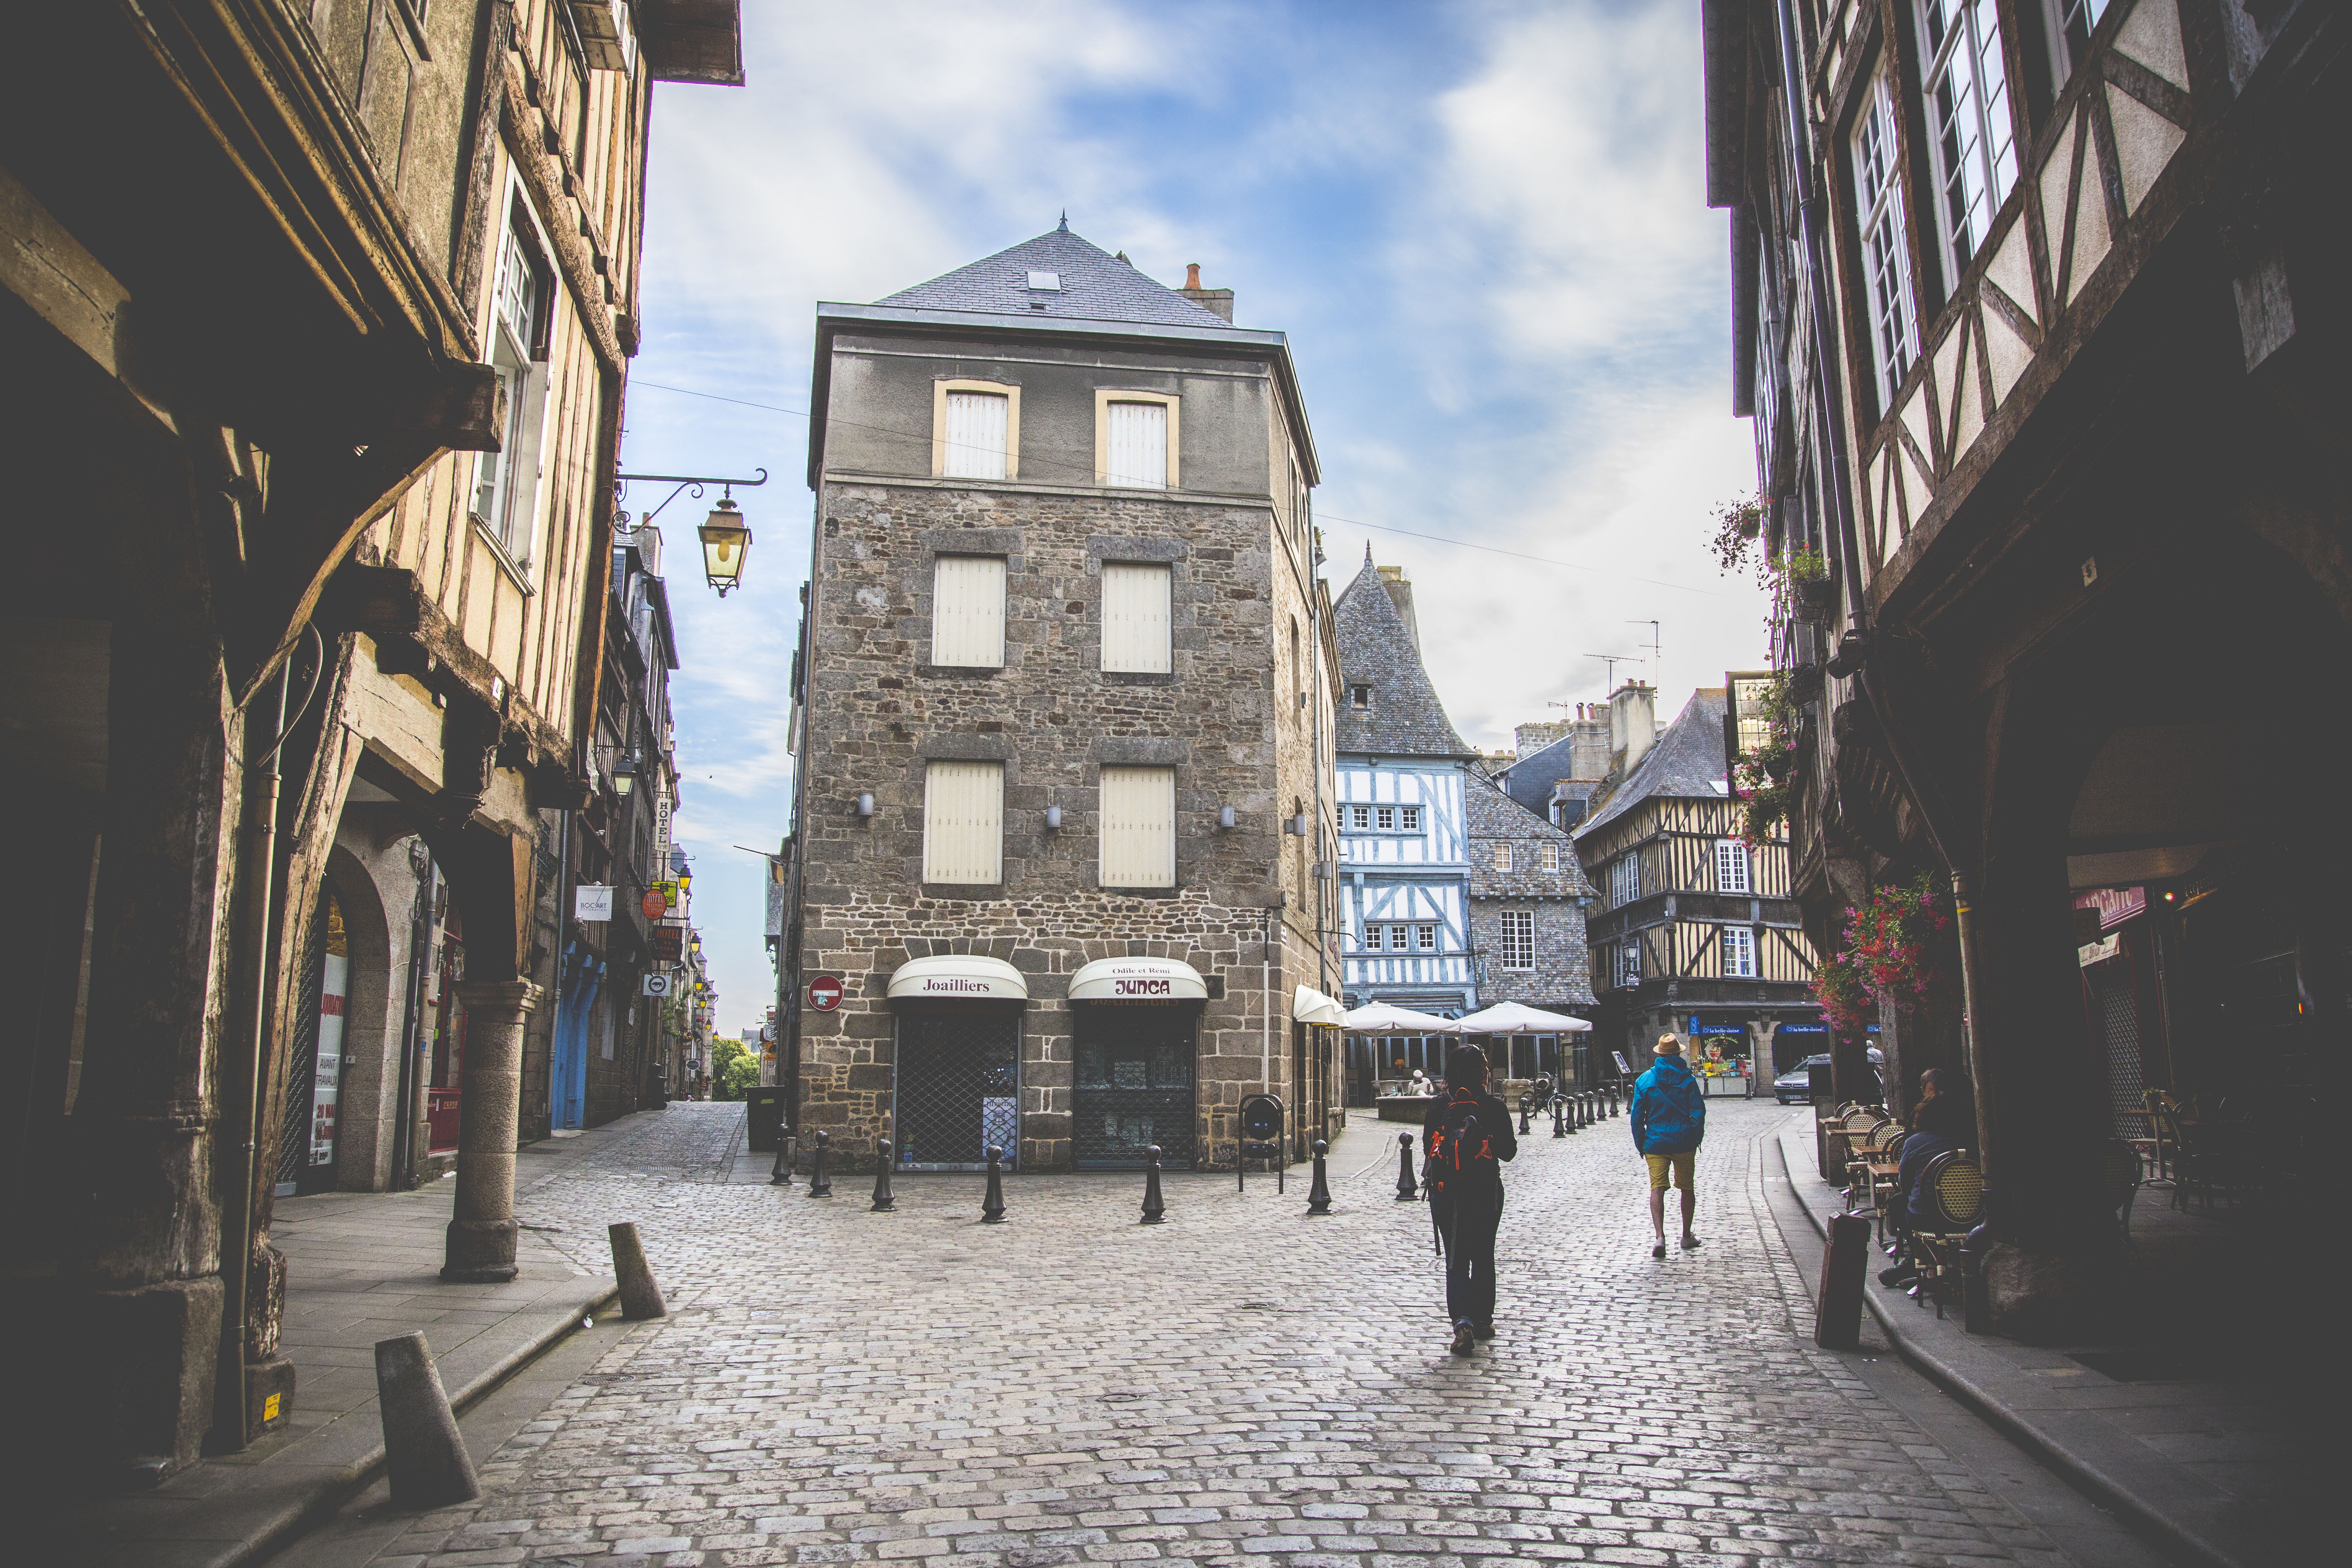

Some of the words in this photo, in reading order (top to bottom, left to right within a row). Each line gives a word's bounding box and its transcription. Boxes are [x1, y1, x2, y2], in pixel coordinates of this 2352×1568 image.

[658, 802, 668, 843] HOTEL
[646, 893, 663, 903] HOTEL
[657, 928, 680, 939] HOTEL
[923, 979, 989, 992] Joailliers
[1115, 980, 1170, 995] JUNCA
[319, 1058, 336, 1069] AVANT
[315, 1074, 337, 1085] TRAVAUX
[316, 1104, 325, 1118] 20
[325, 1104, 336, 1118] MAI
